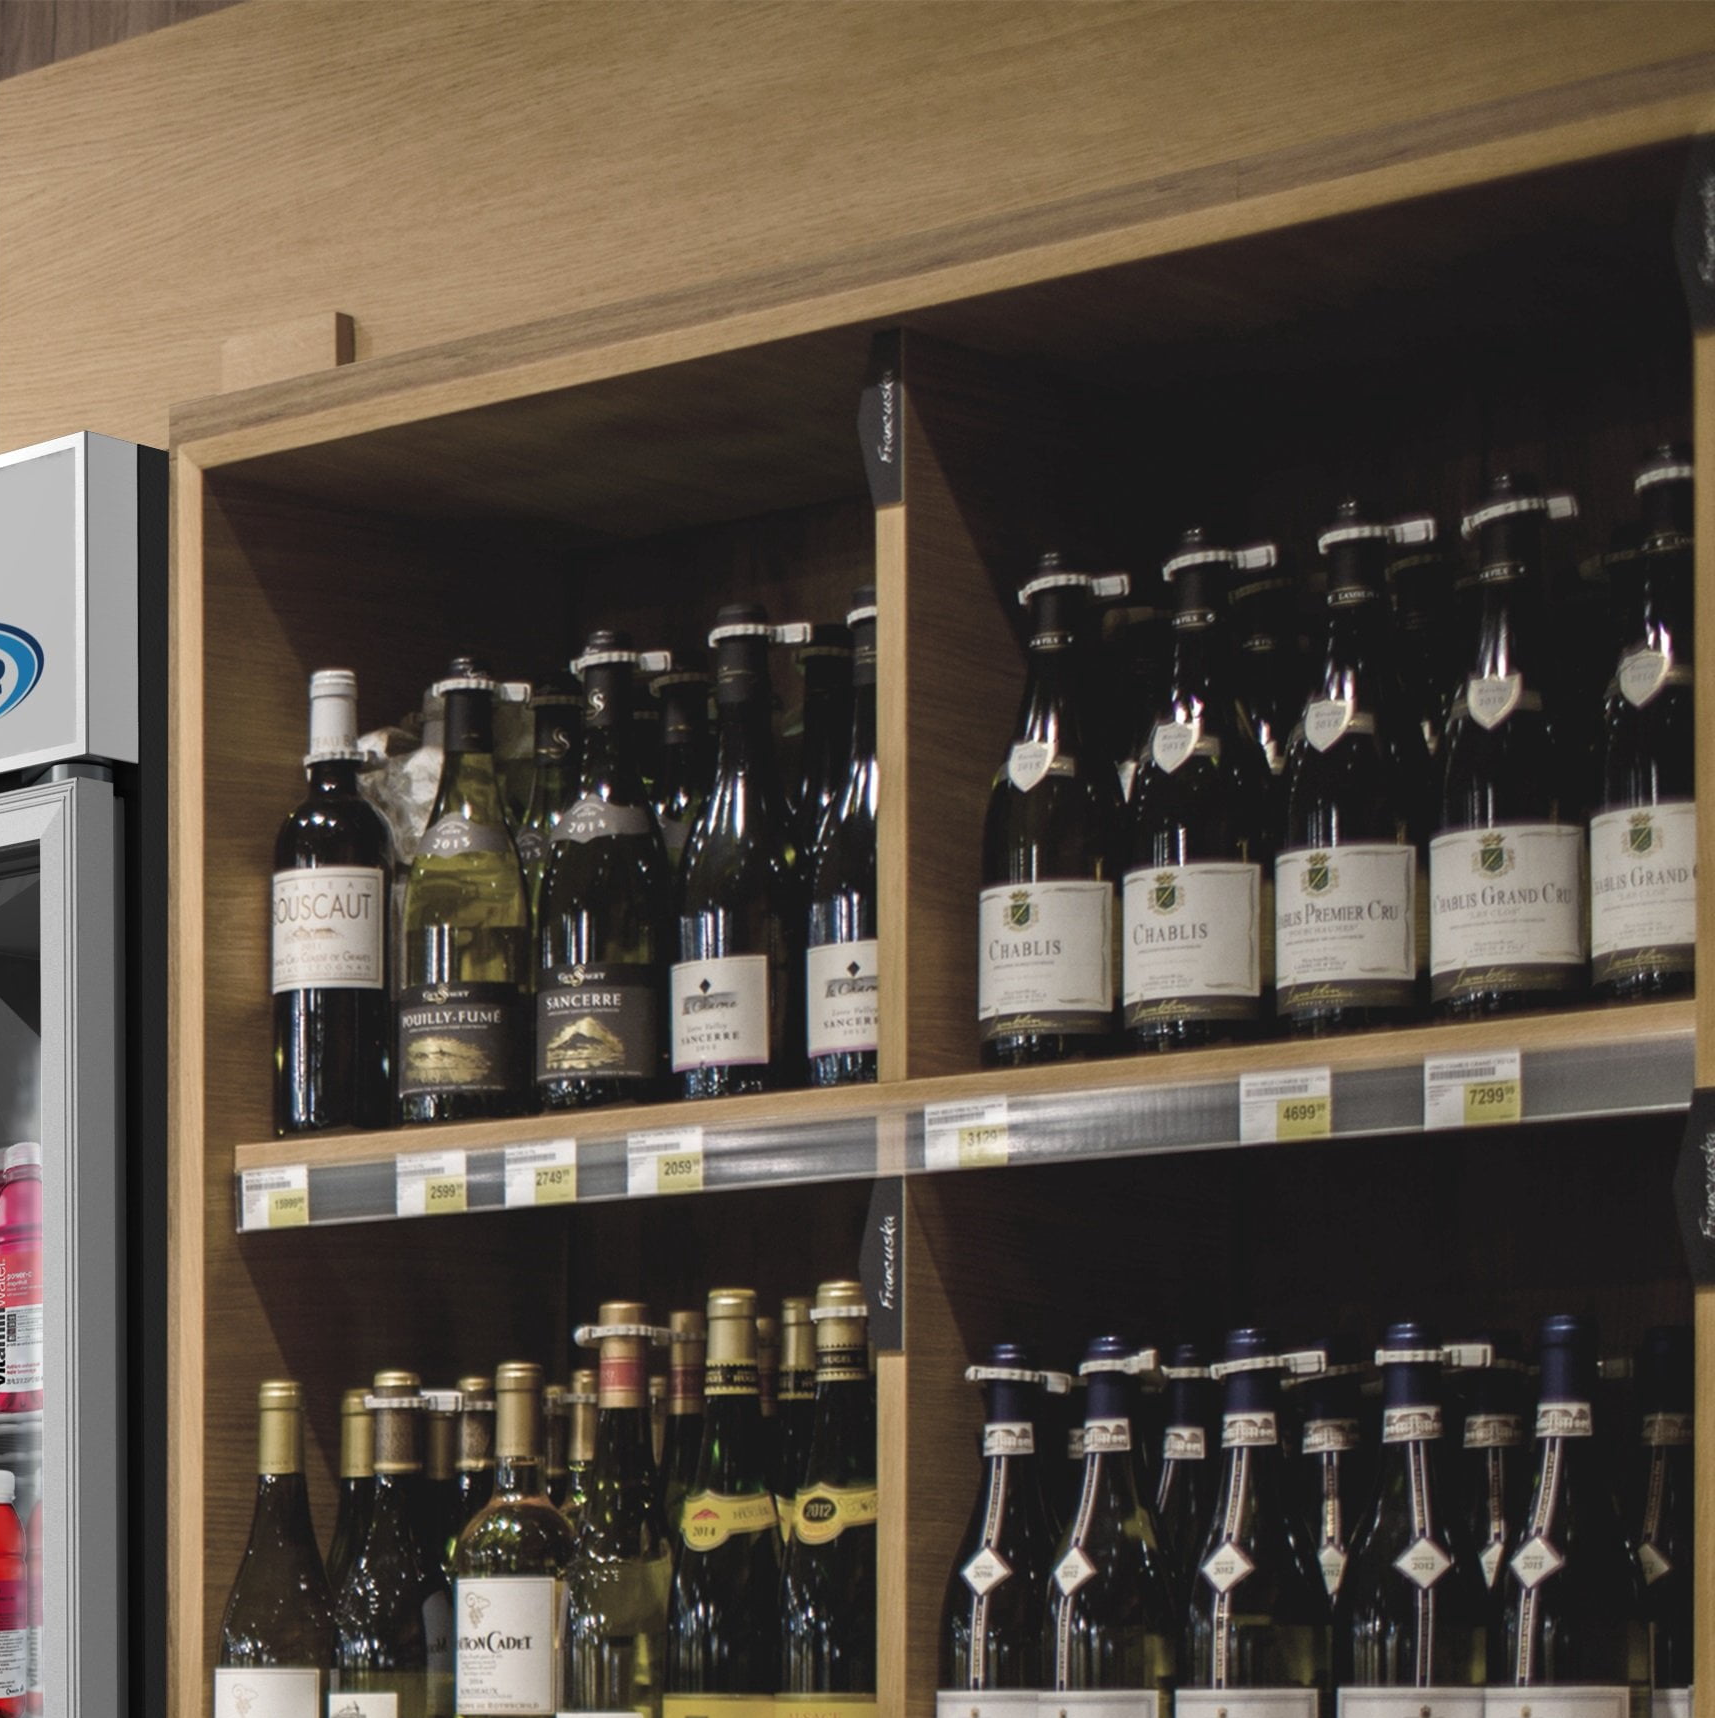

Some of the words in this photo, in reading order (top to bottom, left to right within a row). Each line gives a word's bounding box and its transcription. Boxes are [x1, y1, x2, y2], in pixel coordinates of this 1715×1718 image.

[1630, 866, 1688, 887] GRAND
[1481, 886, 1539, 907] GRAND
[1542, 883, 1572, 904] CRU
[1304, 903, 1365, 926] PREMIER
[1367, 900, 1400, 921] CRU
[1133, 923, 1209, 946] CHABLIS
[988, 939, 1062, 961] CHABLIS
[546, 993, 622, 1010] SANCERRE
[681, 1031, 740, 1045] SANCERRE
[1469, 1087, 1505, 1105] 7299
[1283, 1104, 1316, 1122] 4699
[664, 1159, 692, 1176] 2059
[536, 1170, 563, 1187] 2749
[430, 1184, 456, 1200] 2599
[879, 1216, 896, 1310] Francuska
[805, 1503, 833, 1518] 2012
[692, 1525, 717, 1538] 2014
